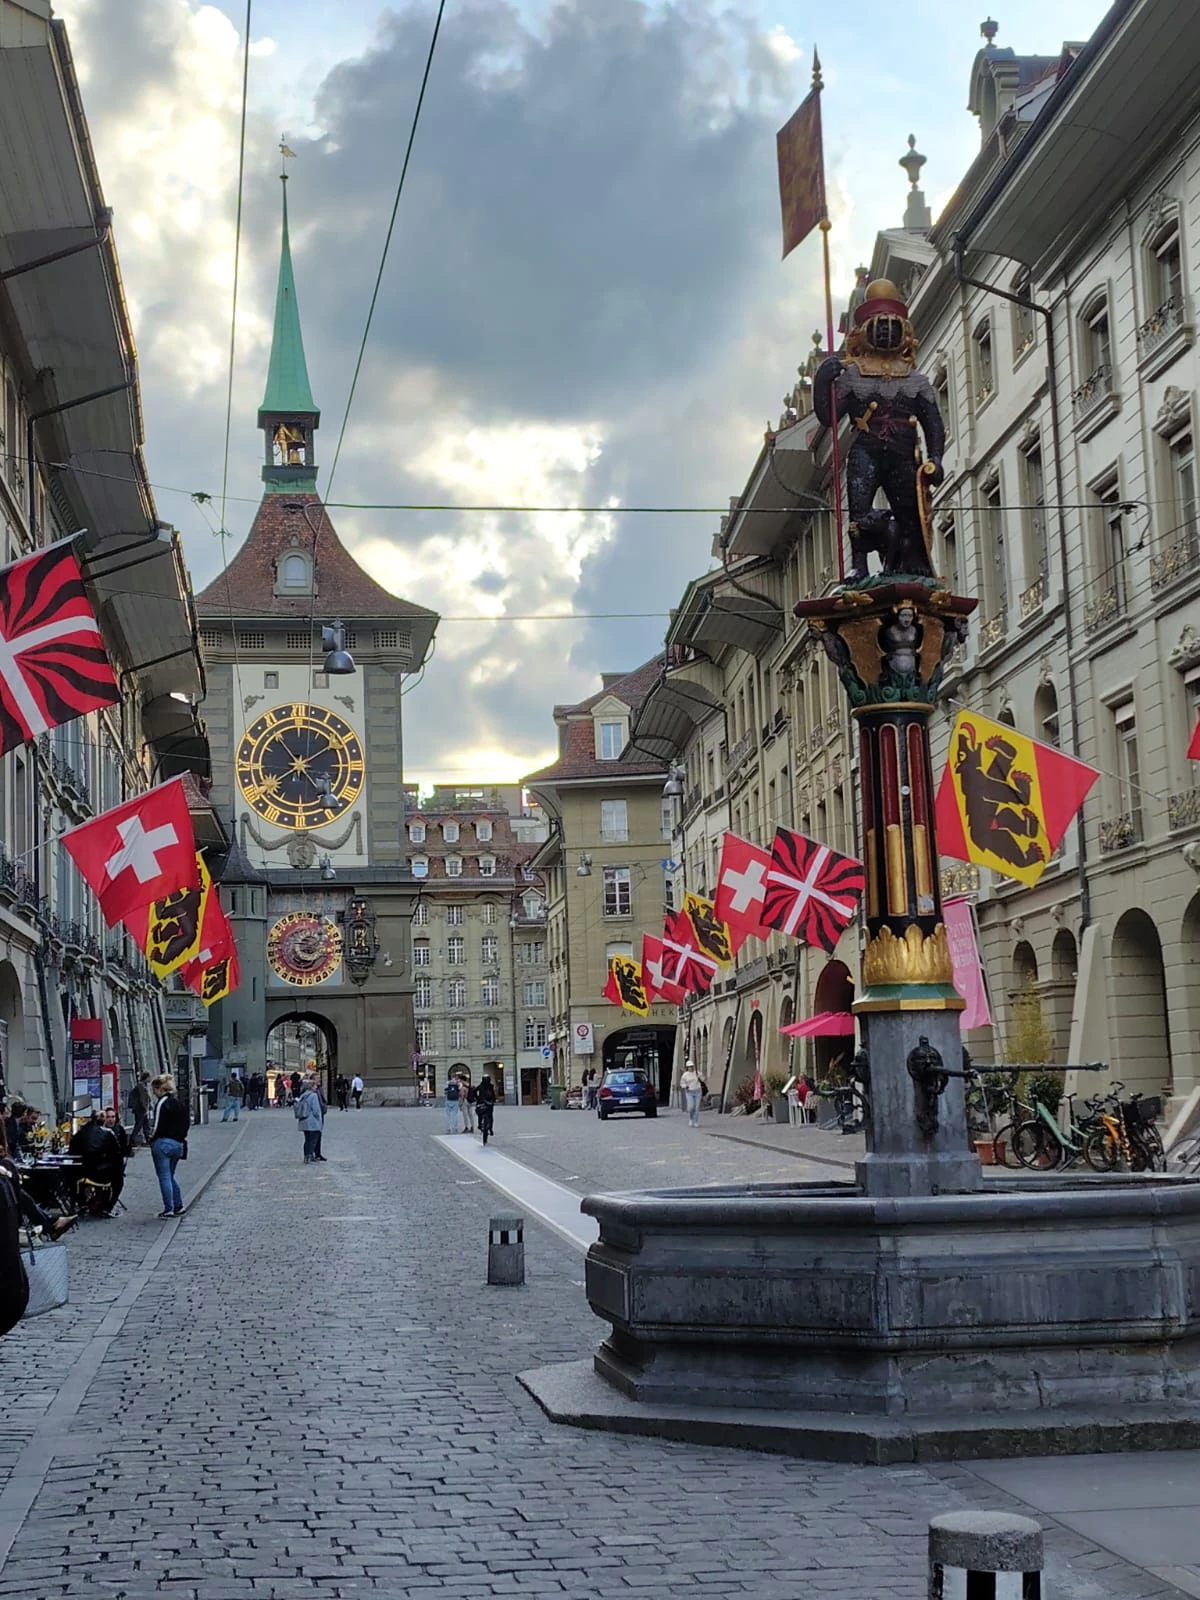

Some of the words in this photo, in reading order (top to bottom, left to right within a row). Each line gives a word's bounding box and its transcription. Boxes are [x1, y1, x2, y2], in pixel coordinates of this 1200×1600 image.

[290, 704, 306, 717] XII
[263, 711, 277, 727] XI
[323, 712, 331, 723] I
[245, 733, 257, 746] X
[341, 732, 354, 744] II
[349, 760, 363, 770] III
